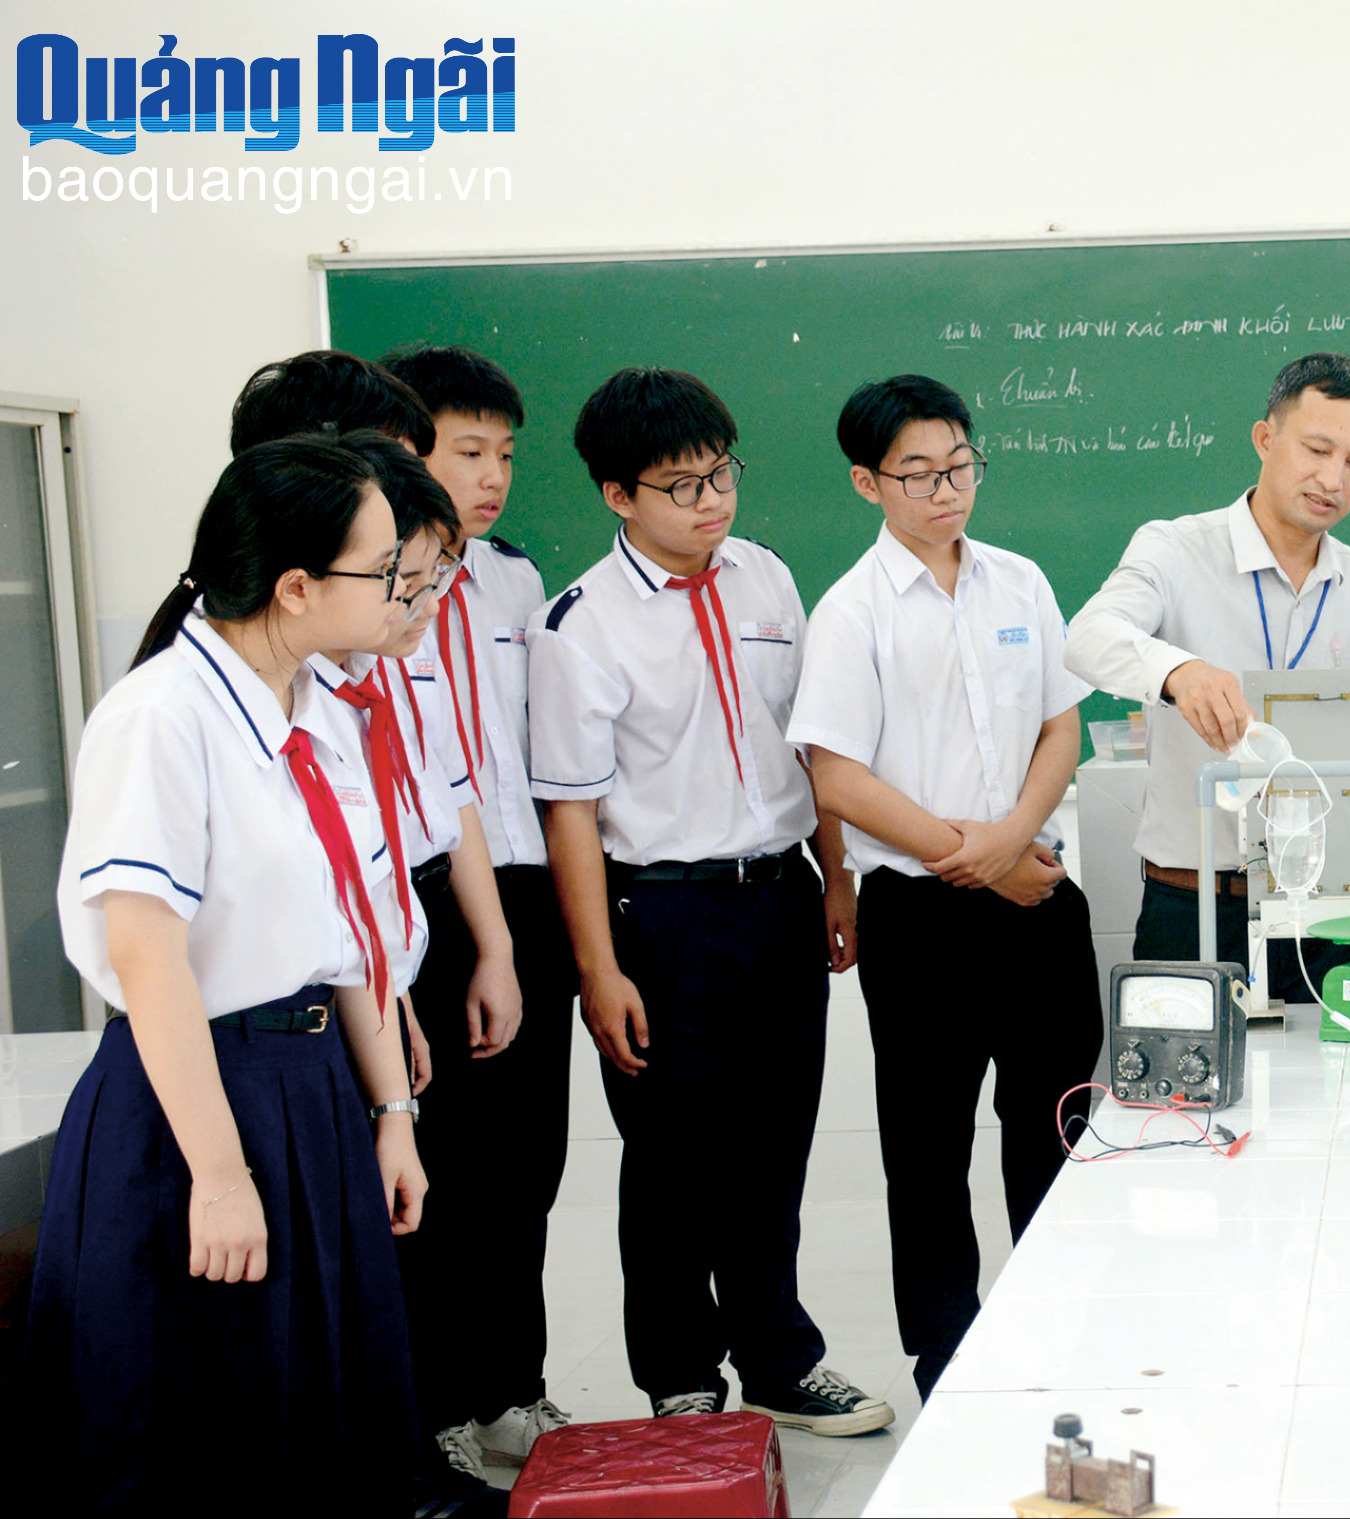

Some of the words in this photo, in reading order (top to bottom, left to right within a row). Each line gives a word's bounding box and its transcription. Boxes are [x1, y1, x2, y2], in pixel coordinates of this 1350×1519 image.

[1058, 315, 1117, 339] HÀNH
[1125, 311, 1165, 338] XÁC
[1239, 303, 1291, 335] KHỐI
